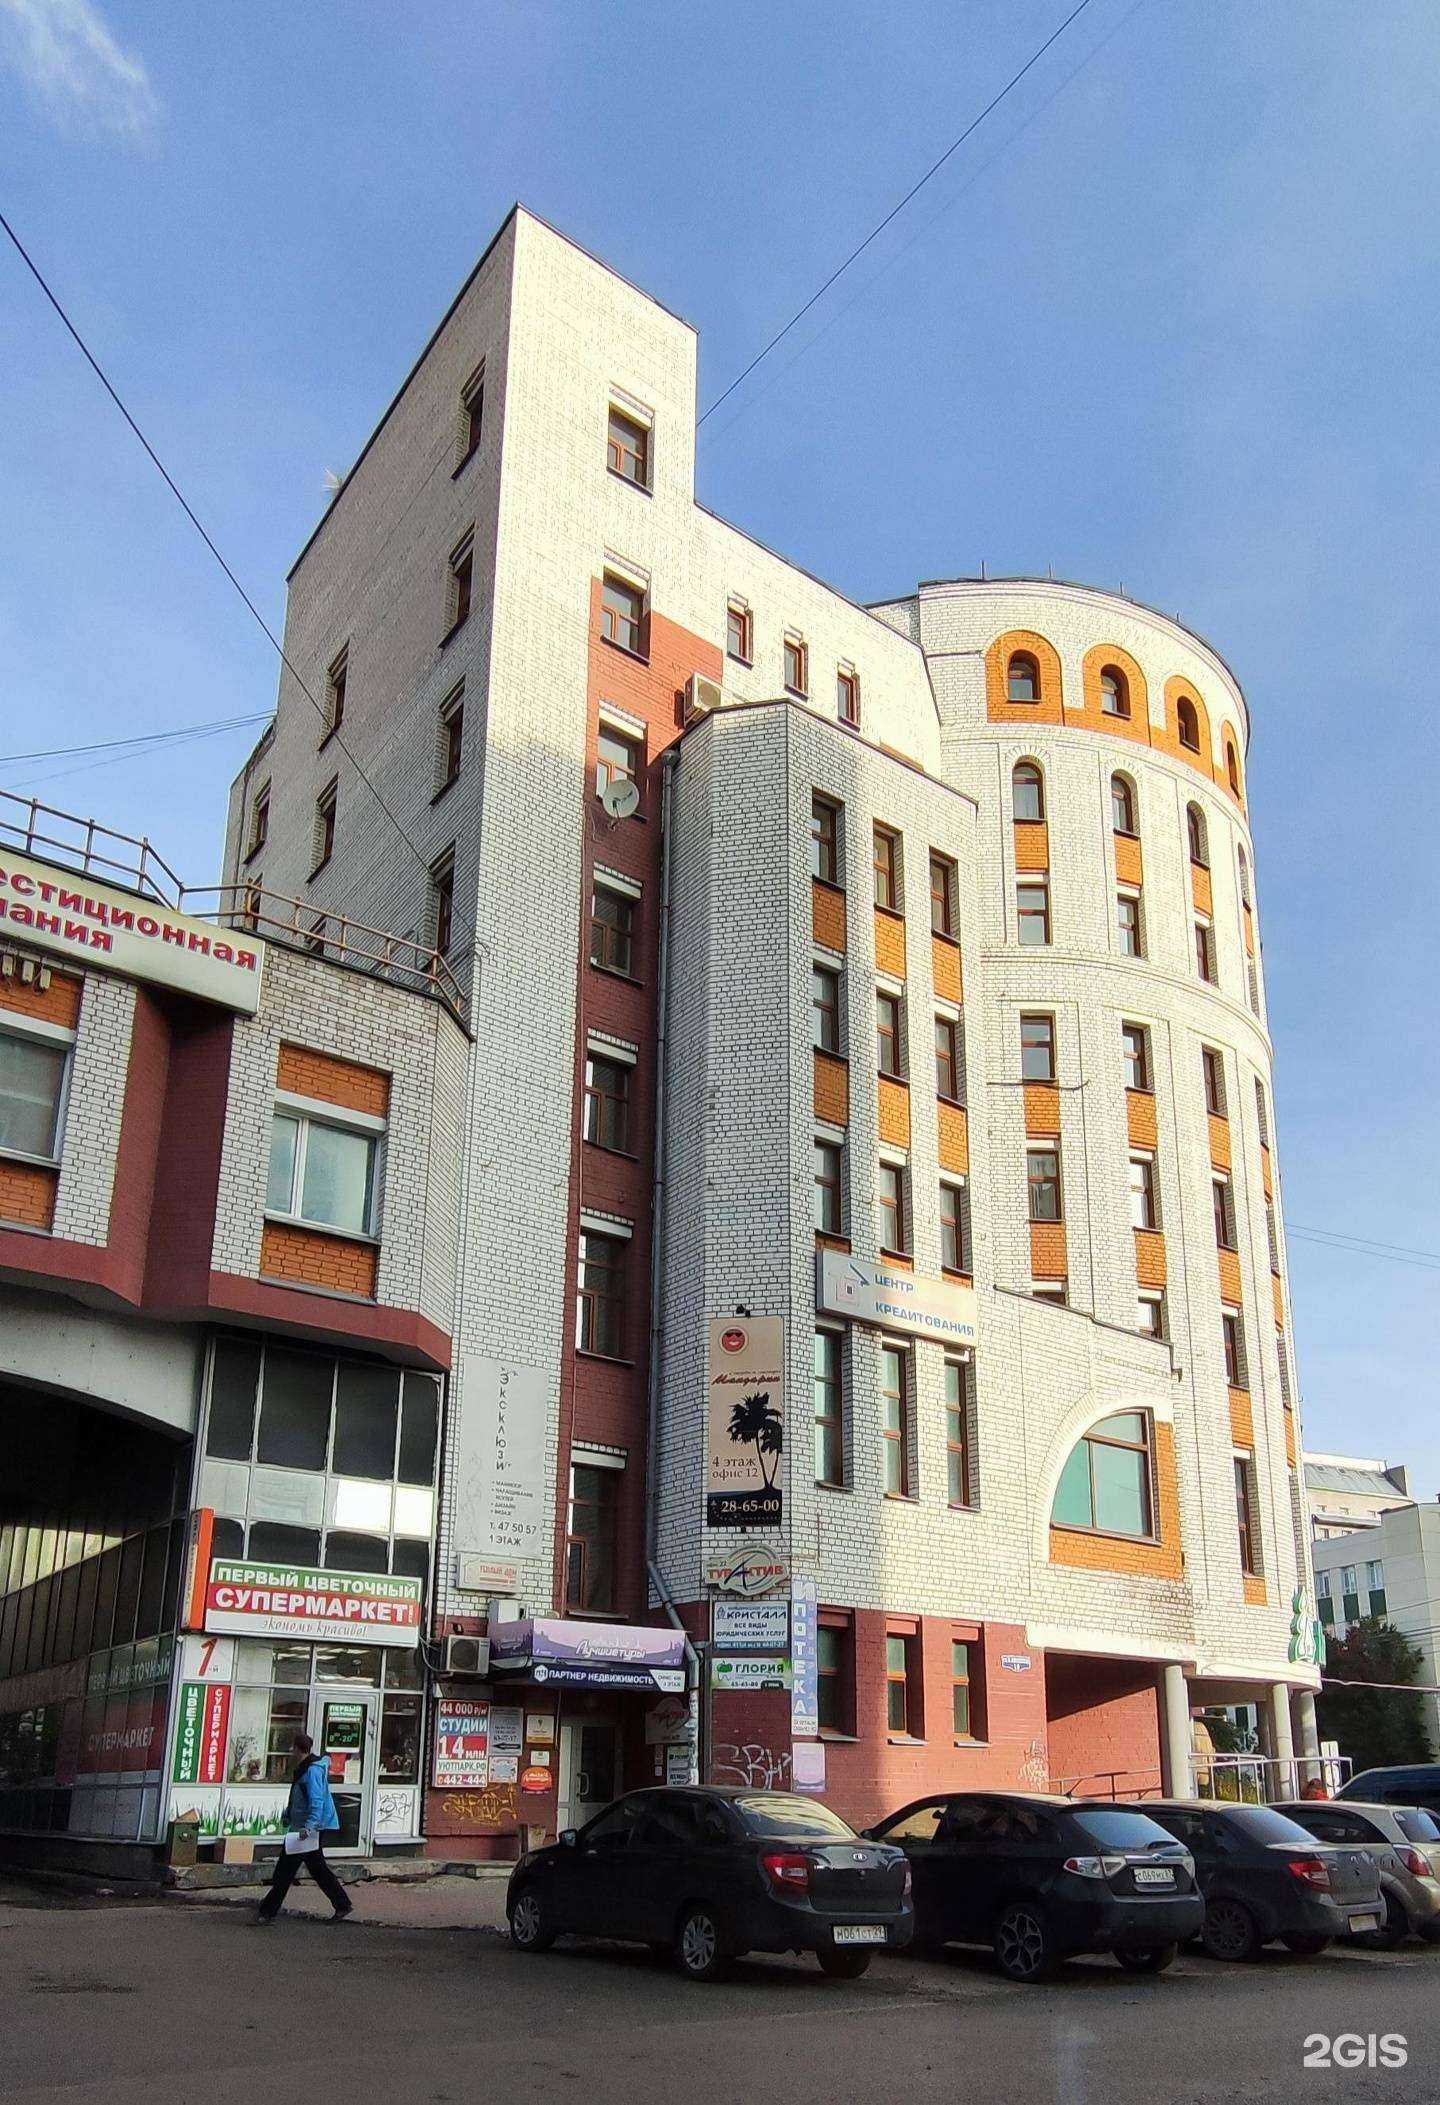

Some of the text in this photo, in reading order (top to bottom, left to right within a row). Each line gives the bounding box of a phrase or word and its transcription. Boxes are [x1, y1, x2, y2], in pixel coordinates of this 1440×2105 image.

[874, 1273, 914, 1293] ЦЕНТР
[875, 1301, 975, 1337] КРЕДИТОВАНИЯ
[712, 1456, 757, 1467] 4 этаж
[712, 1468, 759, 1481] офис 12
[721, 1499, 780, 1512] 28-65-00
[498, 1521, 510, 1531] 47
[512, 1523, 524, 1533] 50
[526, 1525, 537, 1535] 57
[489, 1534, 522, 1546] 1 ЭТАЖ
[218, 1566, 416, 1598] ПЕРВЫЙ ЦВЕТОЧНЫЙ
[215, 1587, 414, 1623] СУПЕРМАРКЕТ!
[727, 1611, 787, 1620] КРИСТАЛЛ
[793, 1582, 816, 1714] ИПОТЕКА
[735, 1663, 784, 1674] ГЛОРИЯ
[548, 1670, 587, 1681] ПАРТНЕР
[588, 1672, 654, 1684] НЕДВИЖИМОСТЬ
[440, 1702, 453, 1714] 44
[455, 1702, 473, 1714] 000
[181, 1687, 198, 1780] ЦВЕТОЧНЫЙ
[440, 1718, 487, 1735] СТУДИИ
[208, 1688, 222, 1780] СУПЕРМАРКЕТ
[438, 1761, 486, 1773] УЮТПАРК.РФ
[443, 1774, 486, 1785] 442-444
